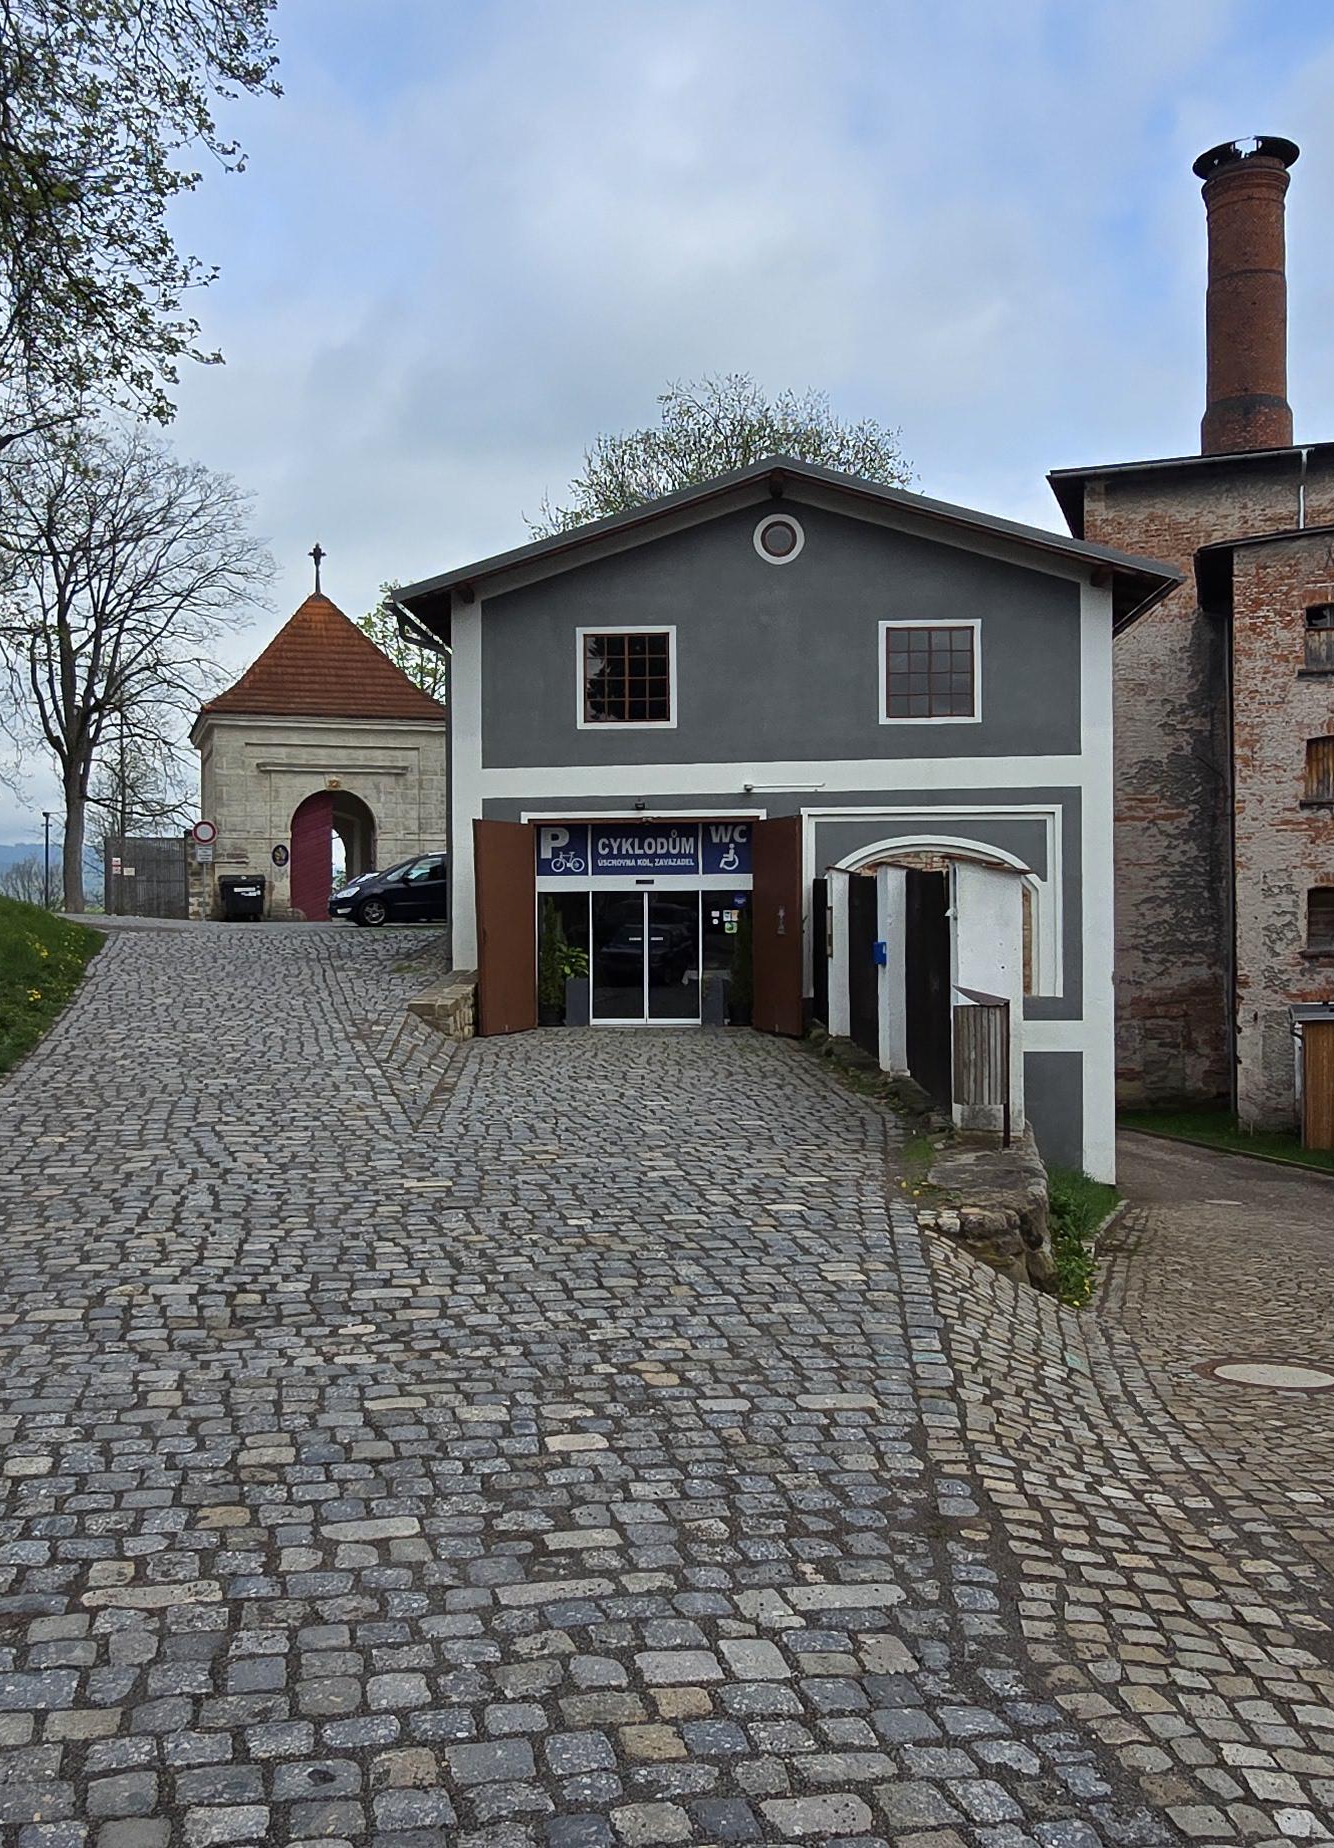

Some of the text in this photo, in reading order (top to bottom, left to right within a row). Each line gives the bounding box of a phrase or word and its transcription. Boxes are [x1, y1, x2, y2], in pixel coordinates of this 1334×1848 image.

[540, 827, 569, 859] P
[598, 829, 694, 855] CYKLODŮM
[709, 825, 747, 843] WC
[654, 858, 695, 866] ZAVAZADEL
